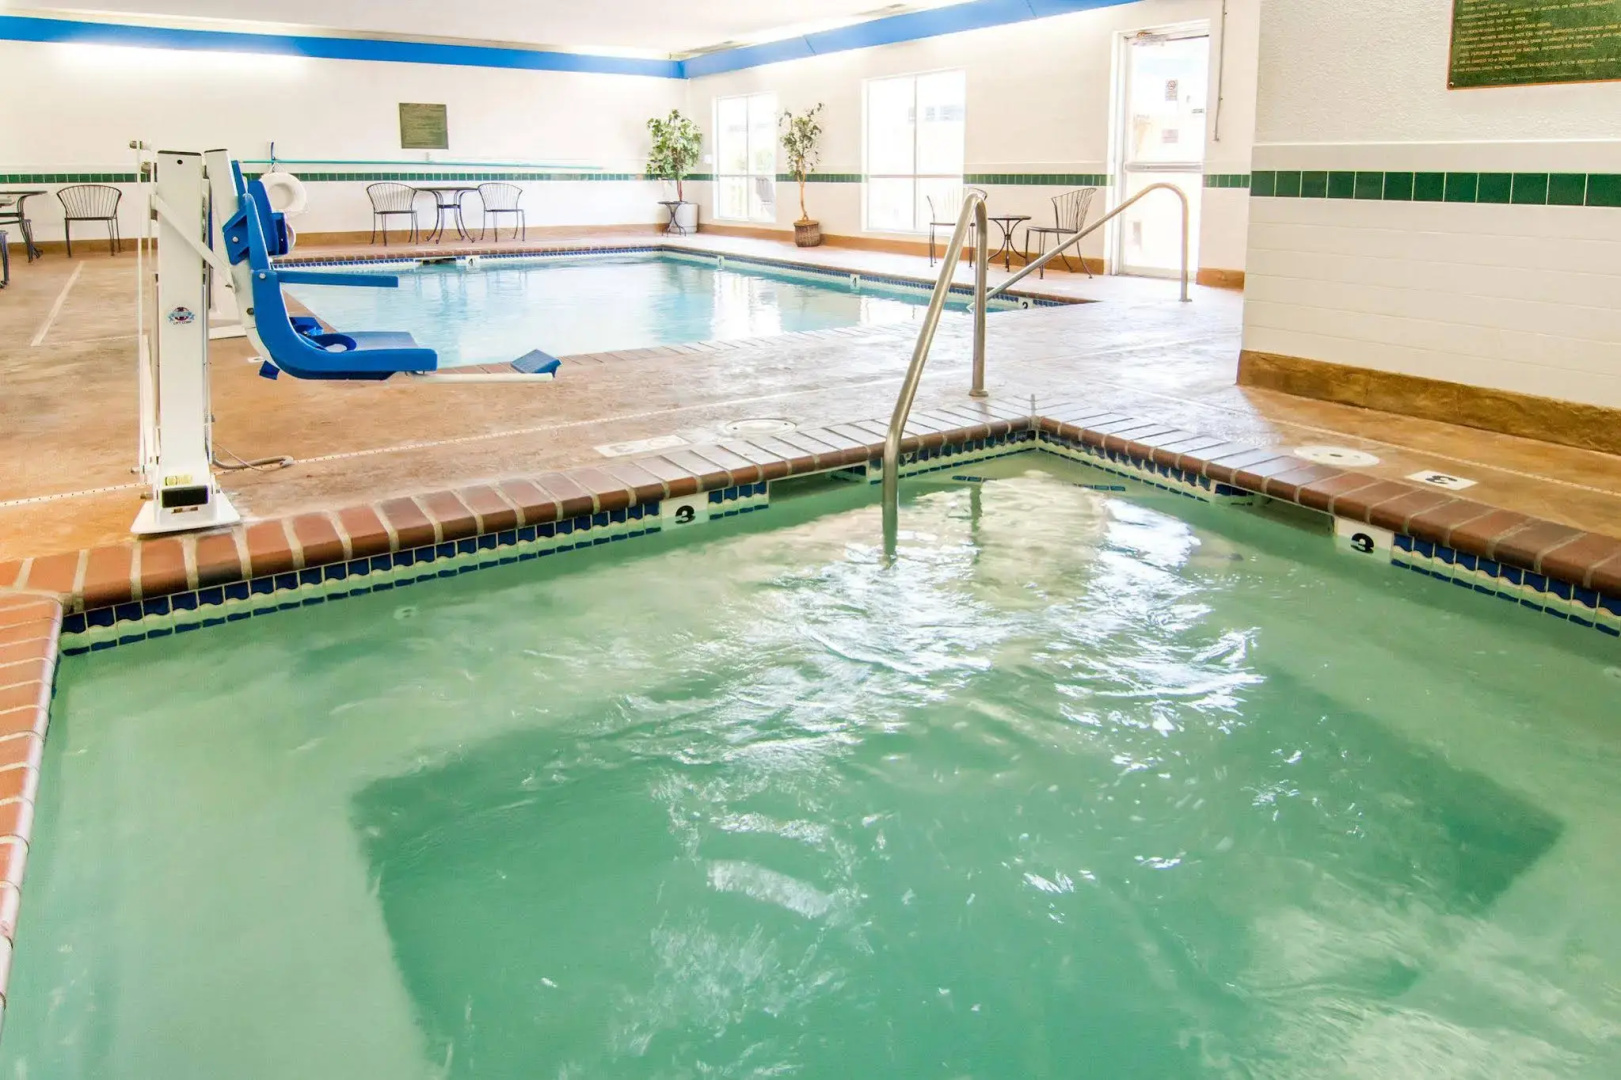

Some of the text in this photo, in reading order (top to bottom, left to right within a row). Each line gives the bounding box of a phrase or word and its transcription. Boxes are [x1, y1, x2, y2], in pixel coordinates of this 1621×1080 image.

[1425, 476, 1457, 484] 3
[675, 505, 696, 524] 3
[1350, 532, 1374, 554] 3
